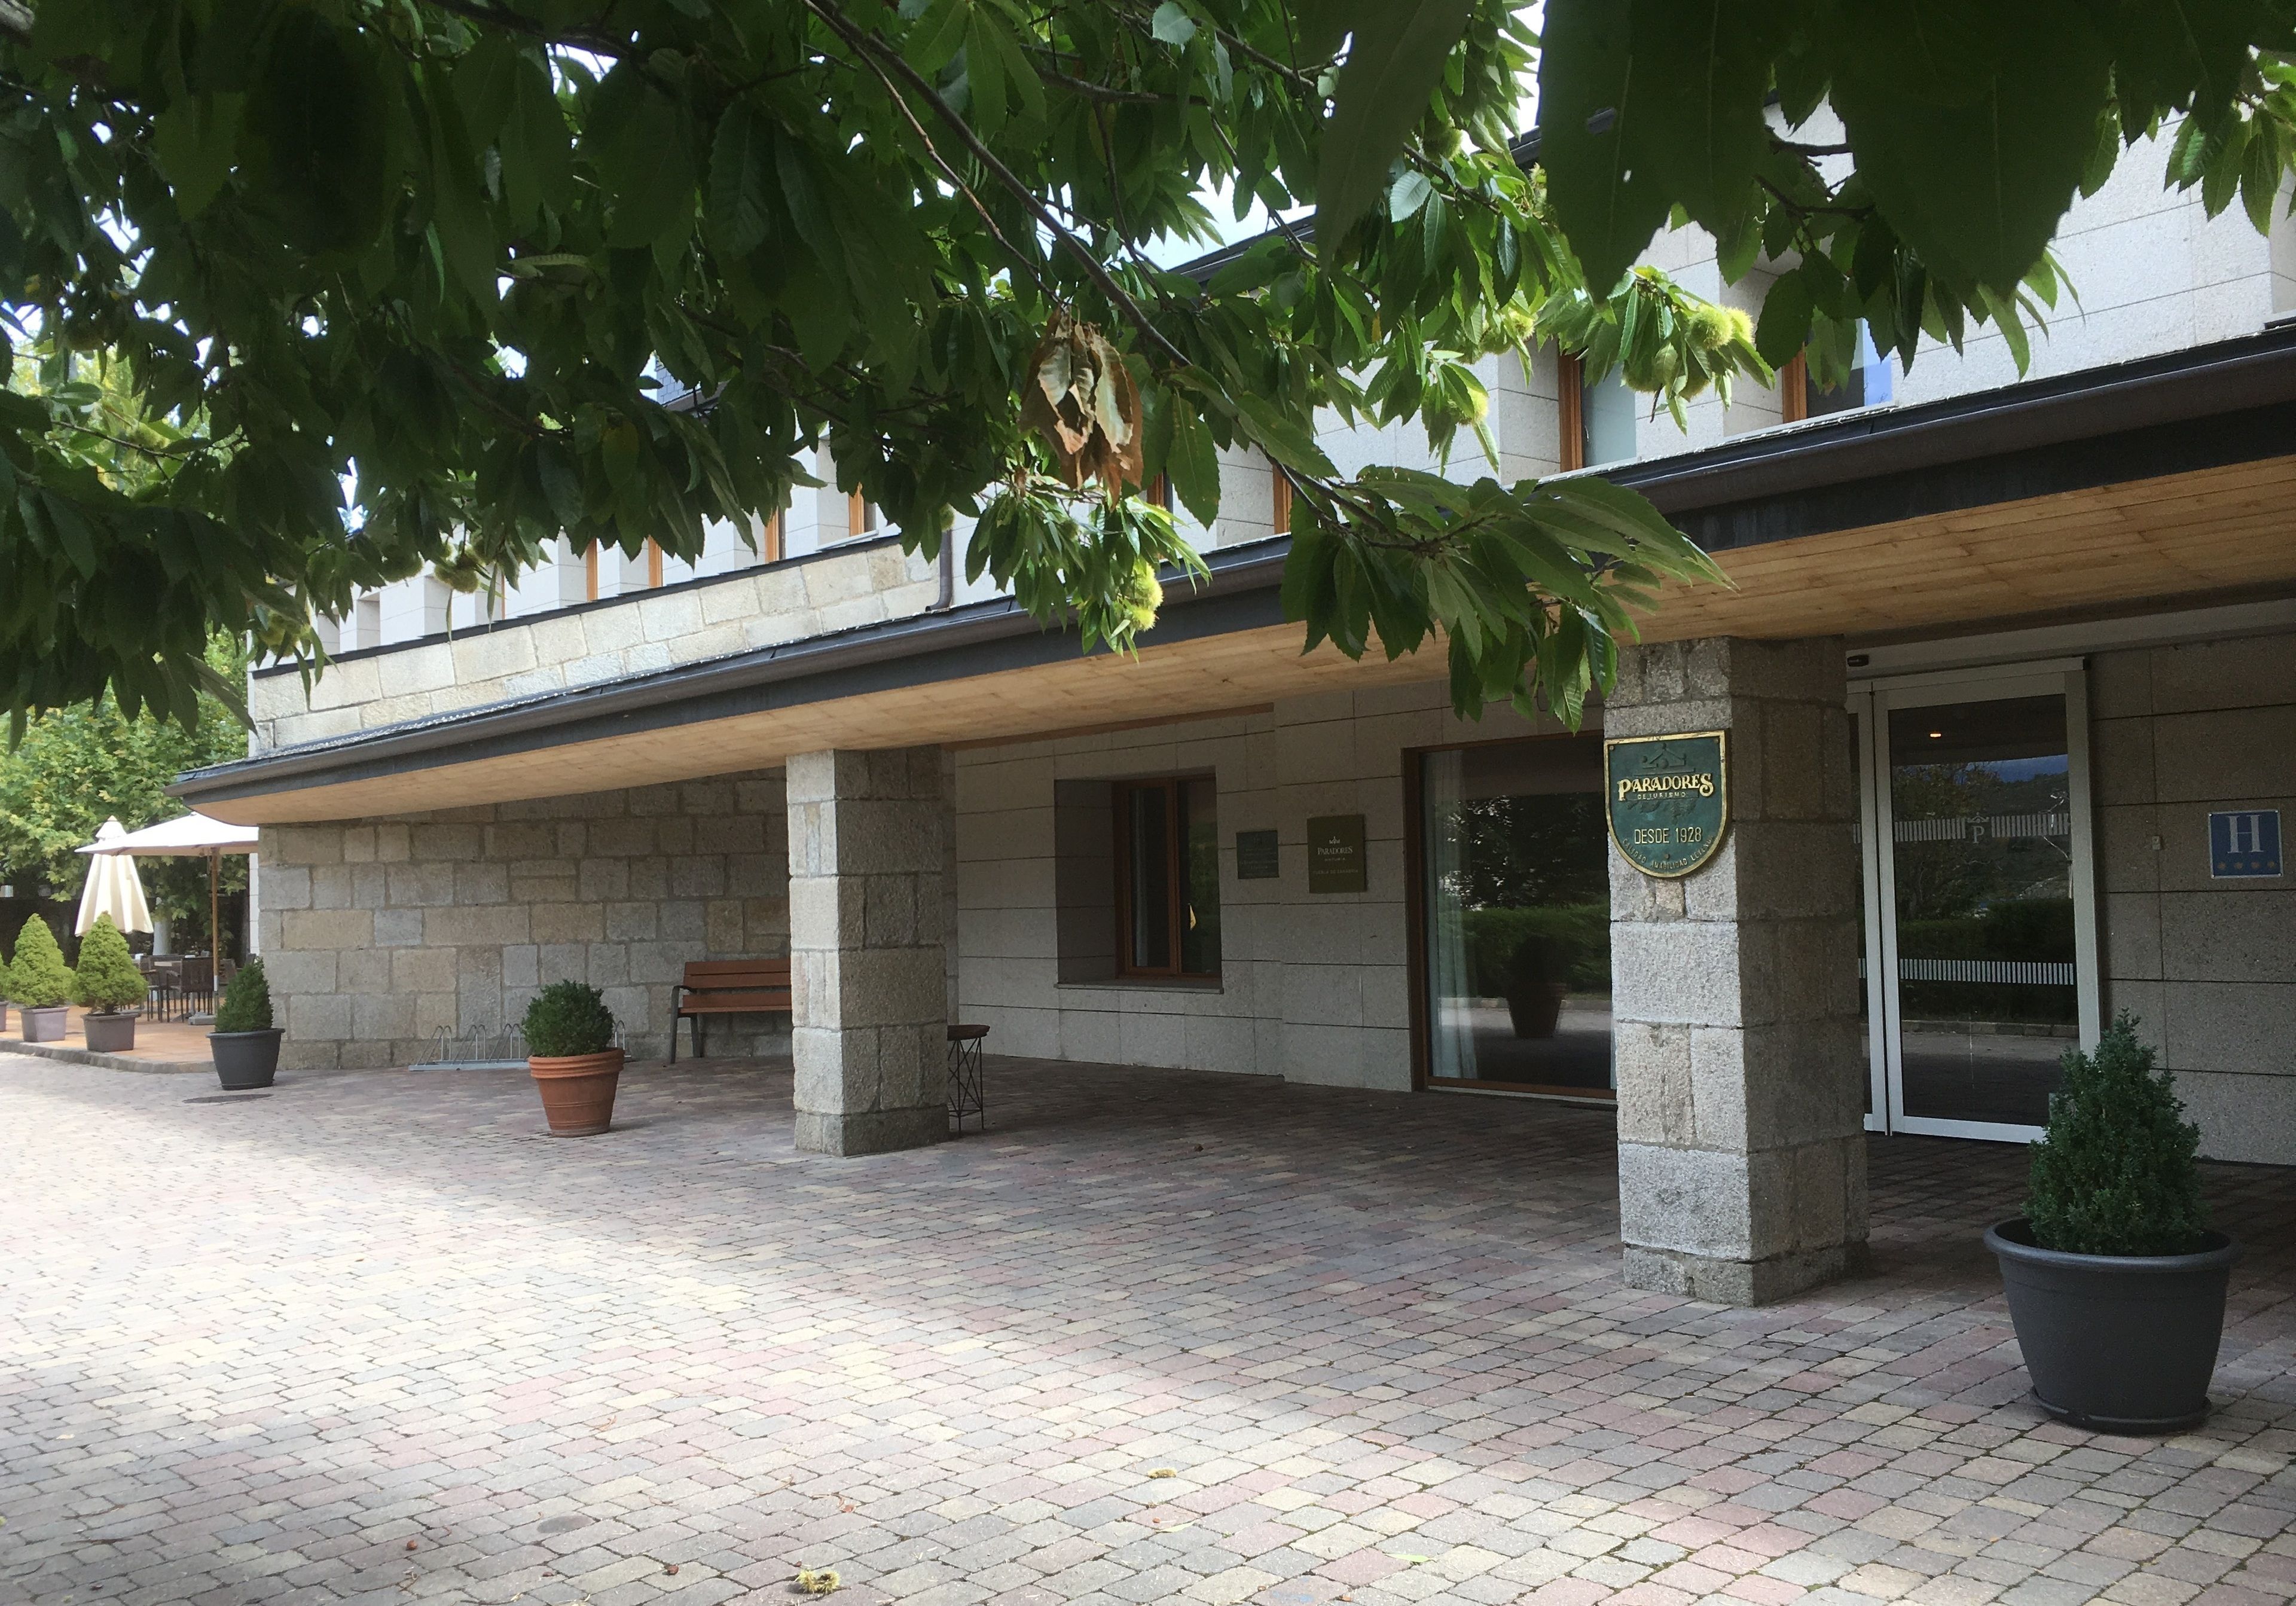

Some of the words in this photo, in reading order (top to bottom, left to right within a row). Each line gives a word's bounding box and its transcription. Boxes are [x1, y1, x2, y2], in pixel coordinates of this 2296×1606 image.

[1617, 773, 1714, 801] PARADORES
[1634, 828, 1670, 844] DESDE
[1675, 826, 1702, 843] 1928
[1971, 825, 1985, 844] P
[2225, 814, 2264, 854] H
[1317, 845, 1353, 855] PARADORES
